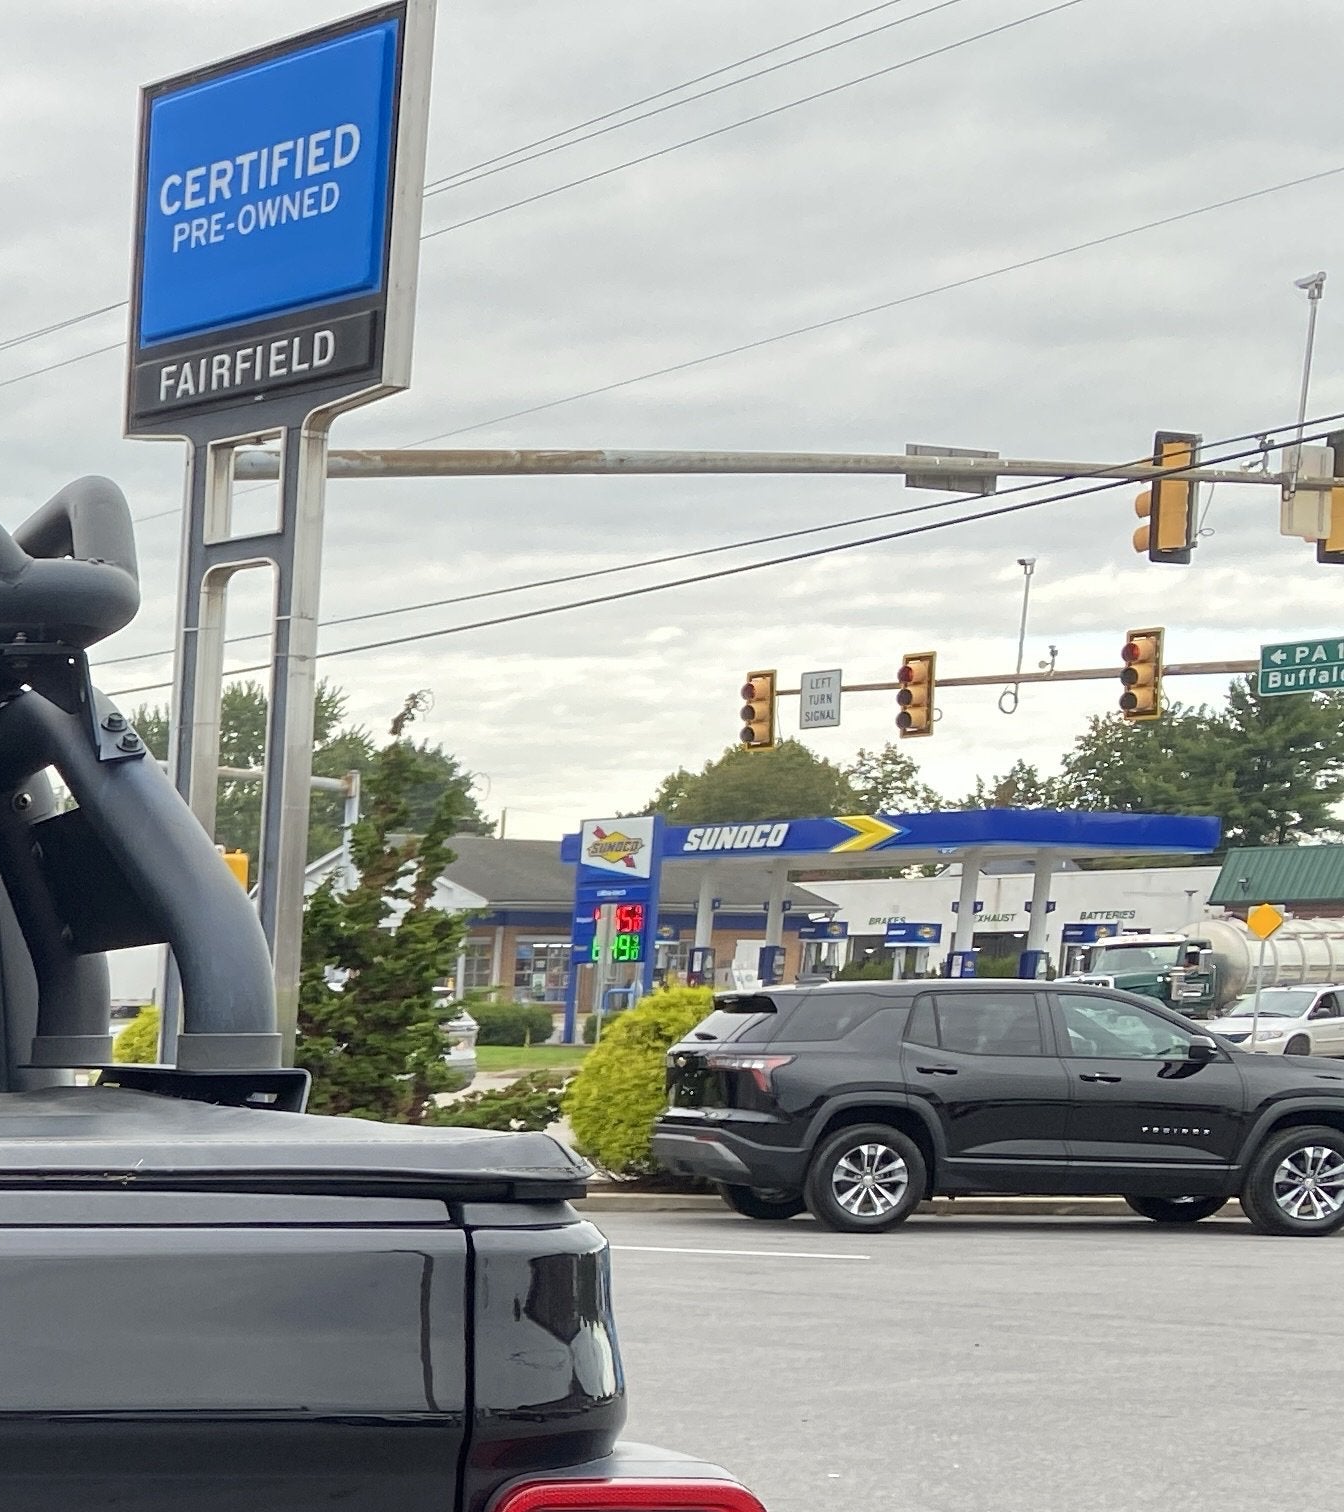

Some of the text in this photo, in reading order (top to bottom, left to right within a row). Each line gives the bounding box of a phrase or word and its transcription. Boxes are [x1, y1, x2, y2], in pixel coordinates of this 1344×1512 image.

[159, 122, 361, 217] CERTIFIED
[172, 181, 340, 253] PRE-OWNED
[159, 329, 336, 402] FAIRFIELD
[1295, 645, 1328, 664] PA
[810, 677, 832, 690] LEFT
[809, 693, 832, 706] TURN
[805, 709, 836, 722] SIGNAL
[683, 823, 790, 851] SUNOCO
[590, 841, 641, 854] SUNOCO
[974, 913, 1017, 923] XHAUST
[1080, 910, 1136, 921] BATTERIES
